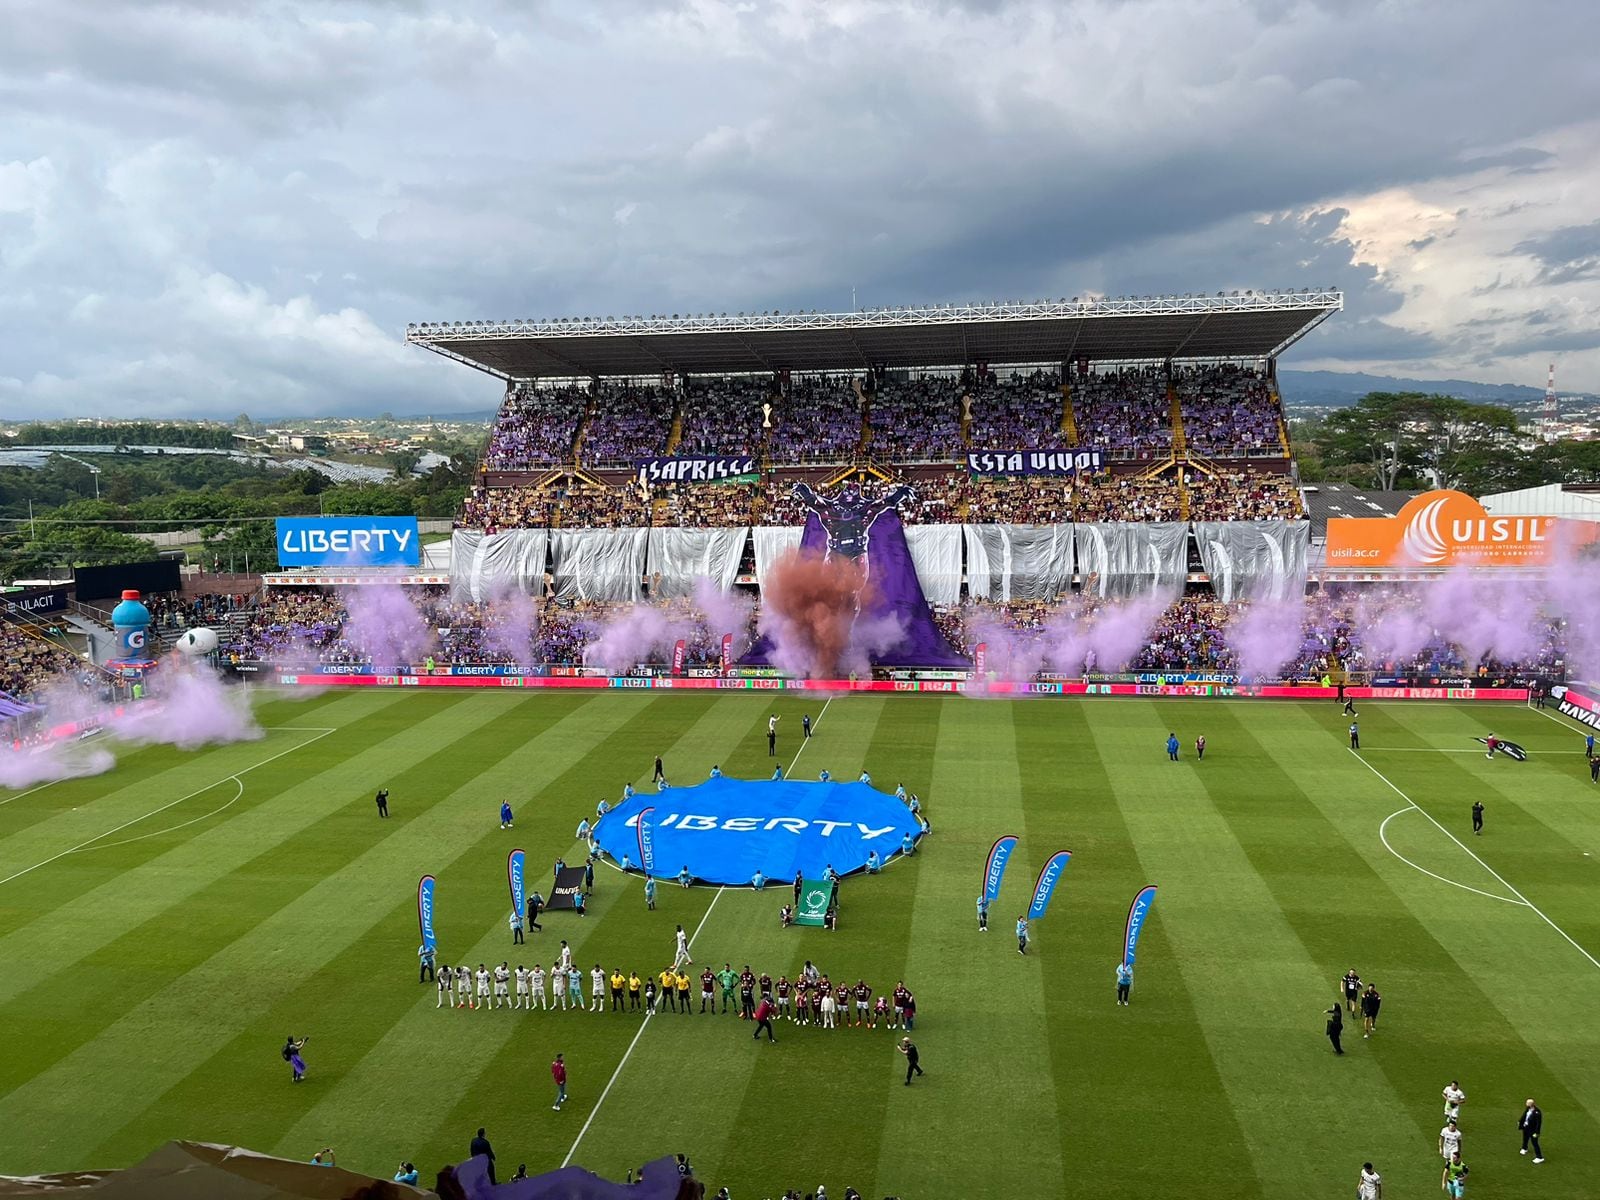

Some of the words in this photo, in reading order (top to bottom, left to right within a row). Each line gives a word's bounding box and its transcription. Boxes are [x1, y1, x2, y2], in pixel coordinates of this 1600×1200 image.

[1030, 452, 1100, 472] VIVO!
[1452, 518, 1545, 542] UISIL
[283, 529, 411, 553] LIBERTY
[1331, 548, 1380, 558] uisil.ac.cr
[20, 594, 54, 610] ULACIT
[128, 631, 145, 649] G
[323, 666, 363, 674] LIBERTY
[457, 667, 497, 675] LIBERTY
[642, 821, 654, 871] LIBERTY
[988, 845, 1008, 894] LIBERTY
[1034, 861, 1059, 911] LIBERTY
